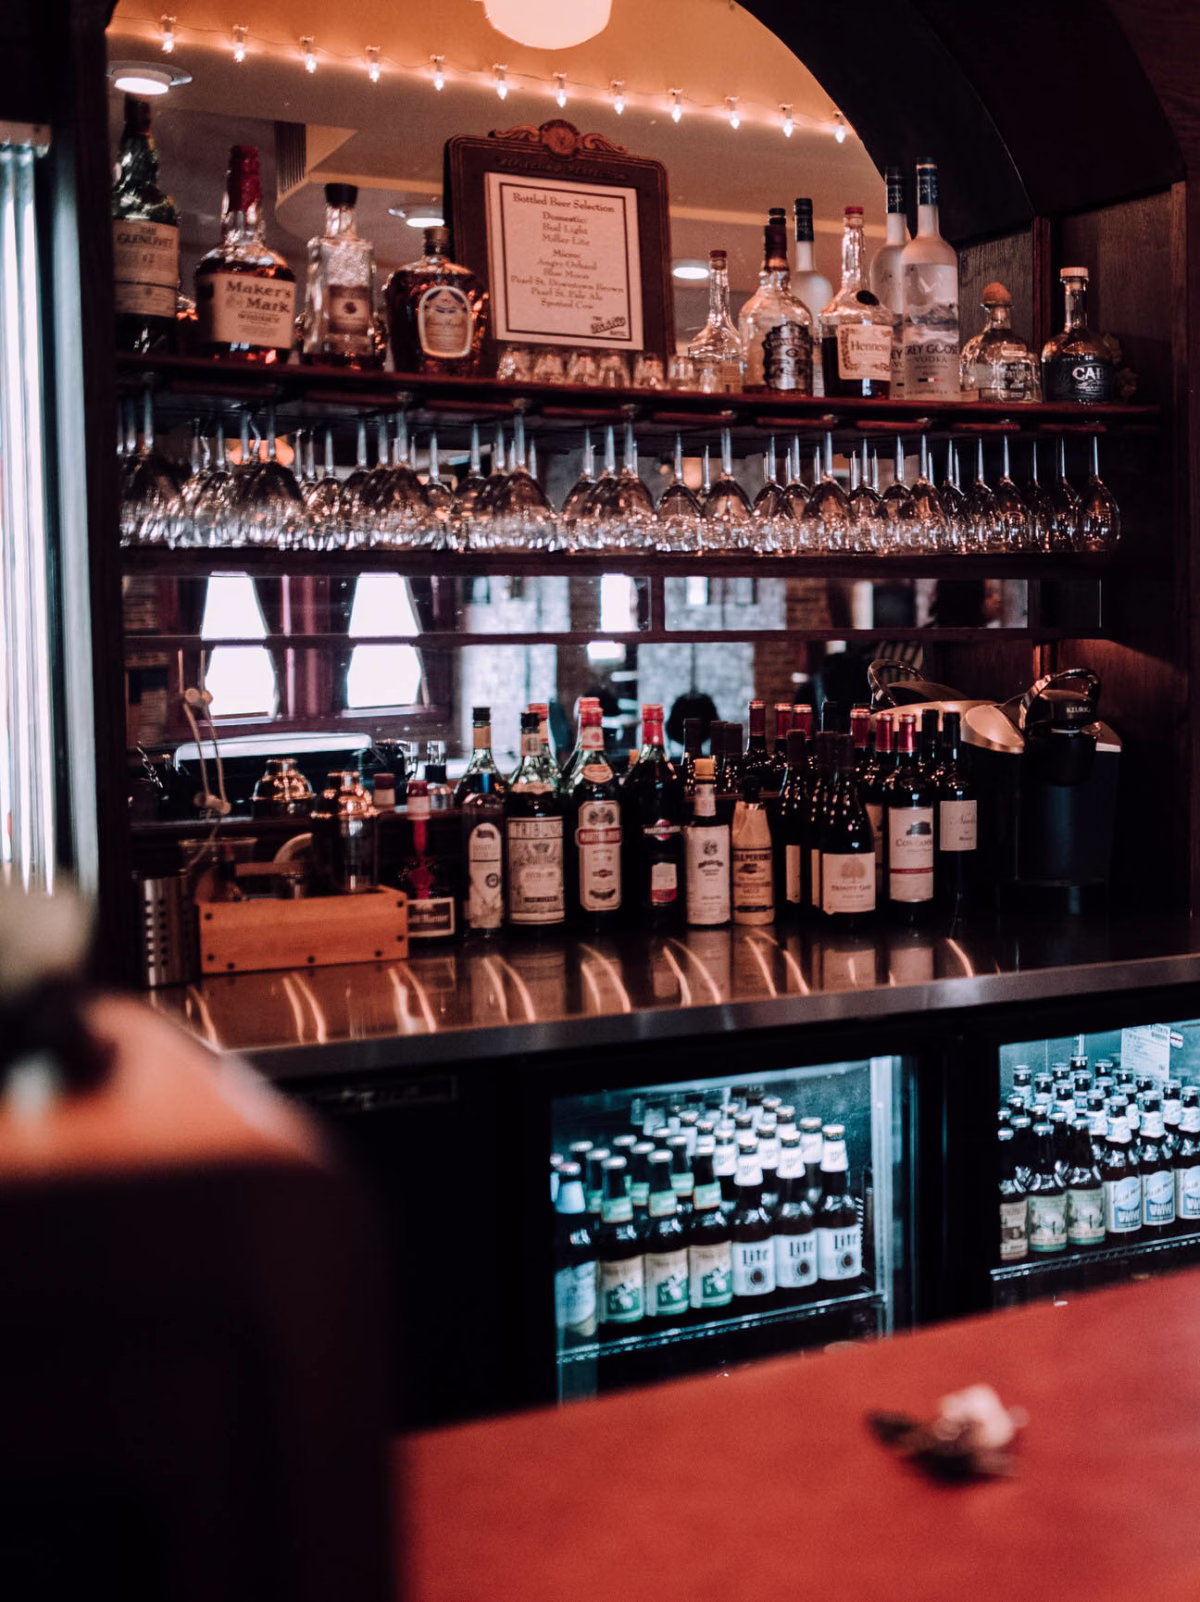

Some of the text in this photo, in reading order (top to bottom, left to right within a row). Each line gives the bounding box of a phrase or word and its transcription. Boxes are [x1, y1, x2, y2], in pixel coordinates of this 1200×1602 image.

[513, 192, 615, 213] Bottled Beer Selection
[542, 222, 588, 235] Bud Light
[117, 232, 174, 249] GLENLIVET
[226, 280, 292, 298] Maker's
[246, 297, 291, 314] Mark
[914, 355, 948, 364] VODKA
